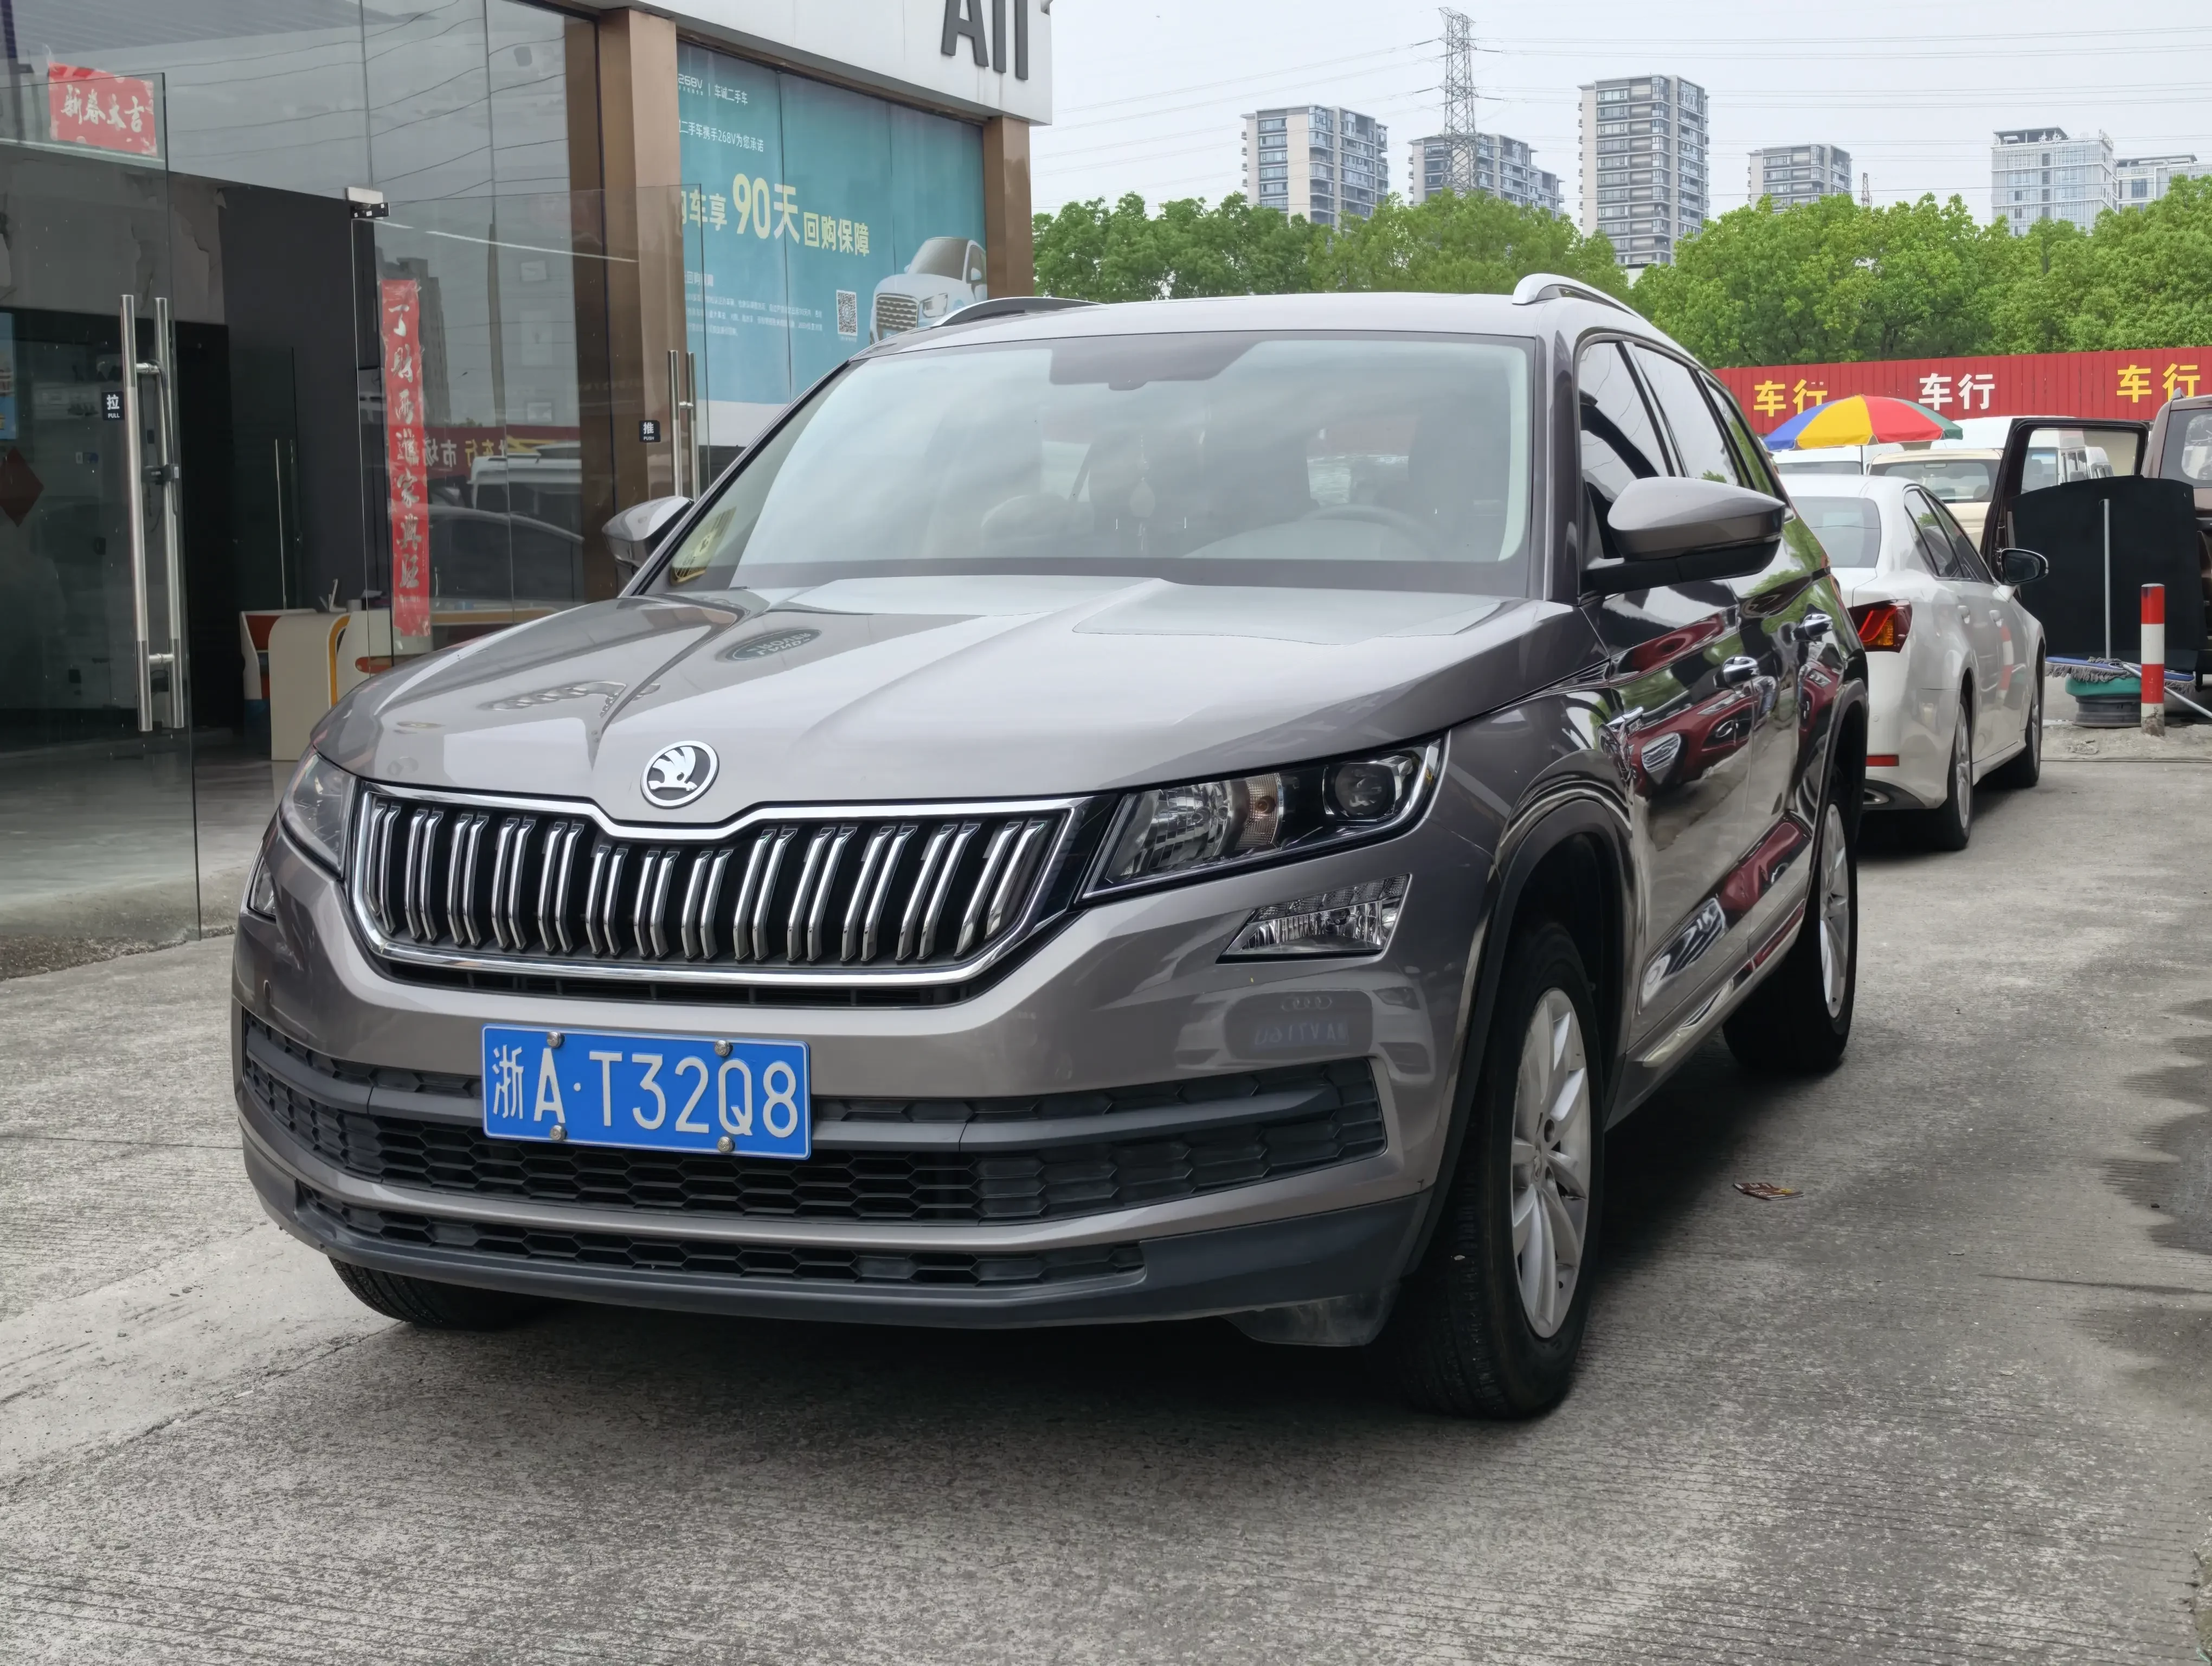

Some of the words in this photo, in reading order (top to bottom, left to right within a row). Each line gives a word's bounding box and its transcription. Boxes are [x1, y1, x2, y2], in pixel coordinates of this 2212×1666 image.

[678, 74, 703, 89] 268V
[679, 119, 764, 152] 二手车携手268V为您承诺
[1753, 379, 1828, 417] 车行
[1918, 373, 1996, 411] 车行
[2116, 363, 2201, 403] 车行
[106, 394, 120, 411] 拉
[643, 421, 654, 434] 推
